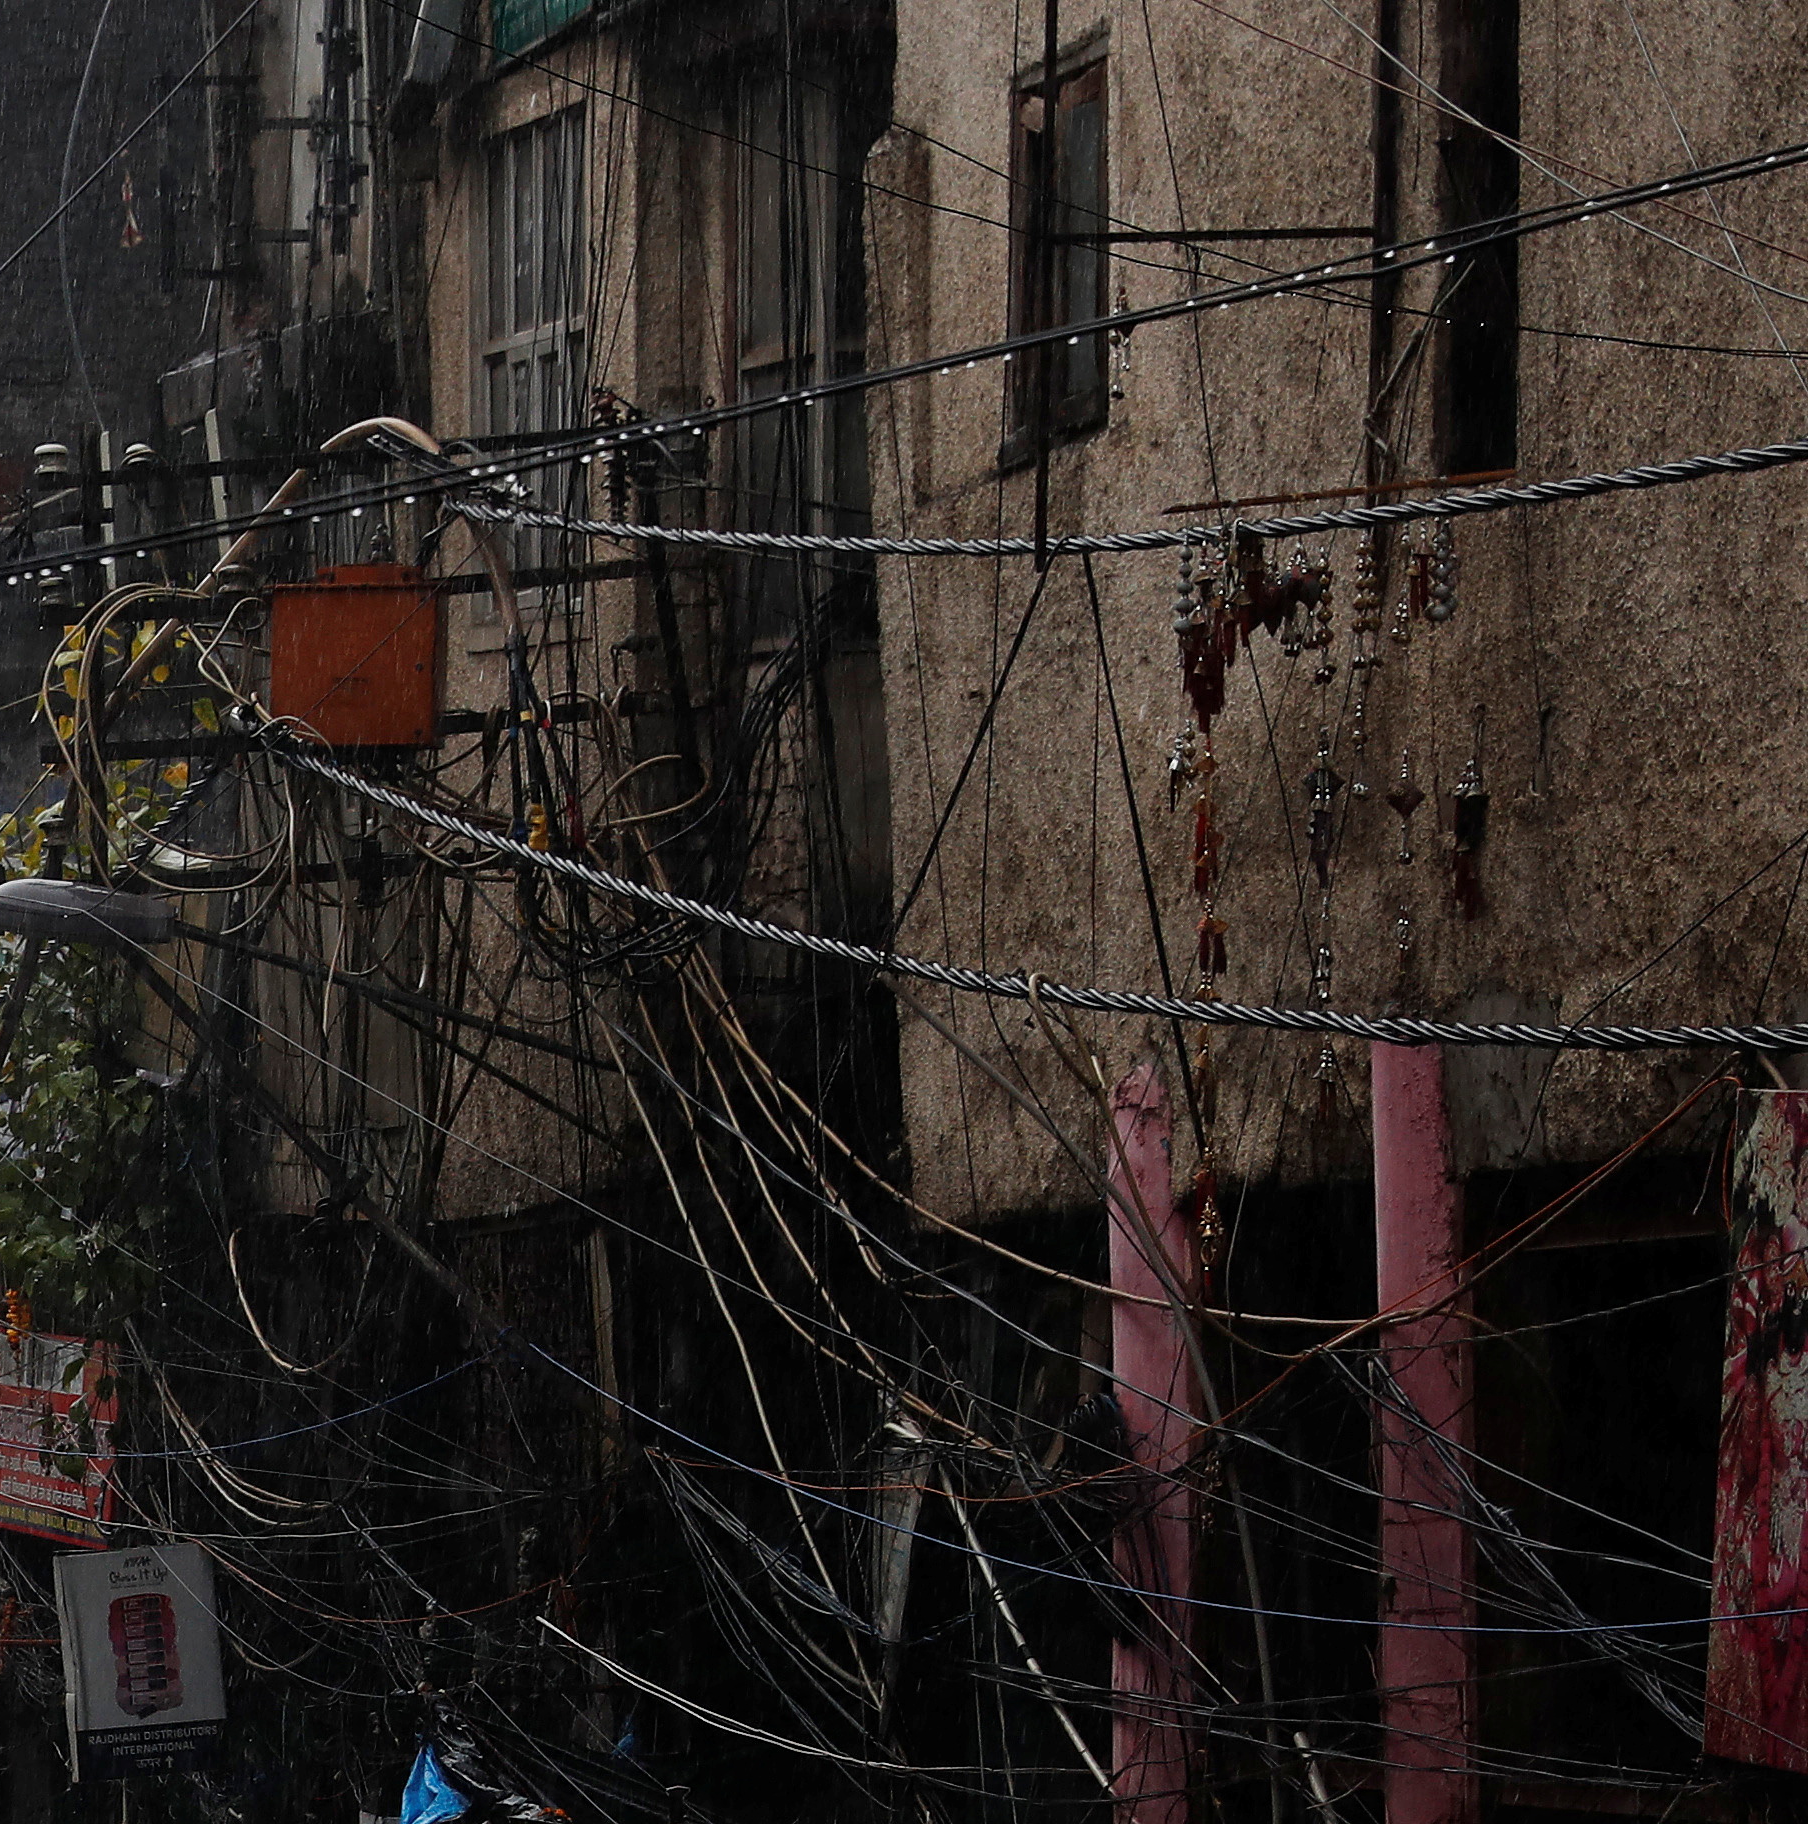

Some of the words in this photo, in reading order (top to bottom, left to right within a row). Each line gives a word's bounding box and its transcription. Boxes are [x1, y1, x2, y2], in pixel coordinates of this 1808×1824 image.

[88, 1732, 141, 1746] RAJDHANI
[144, 1725, 218, 1741] DISTRIBUTORS
[113, 1740, 196, 1757] INTERNATIONAL
